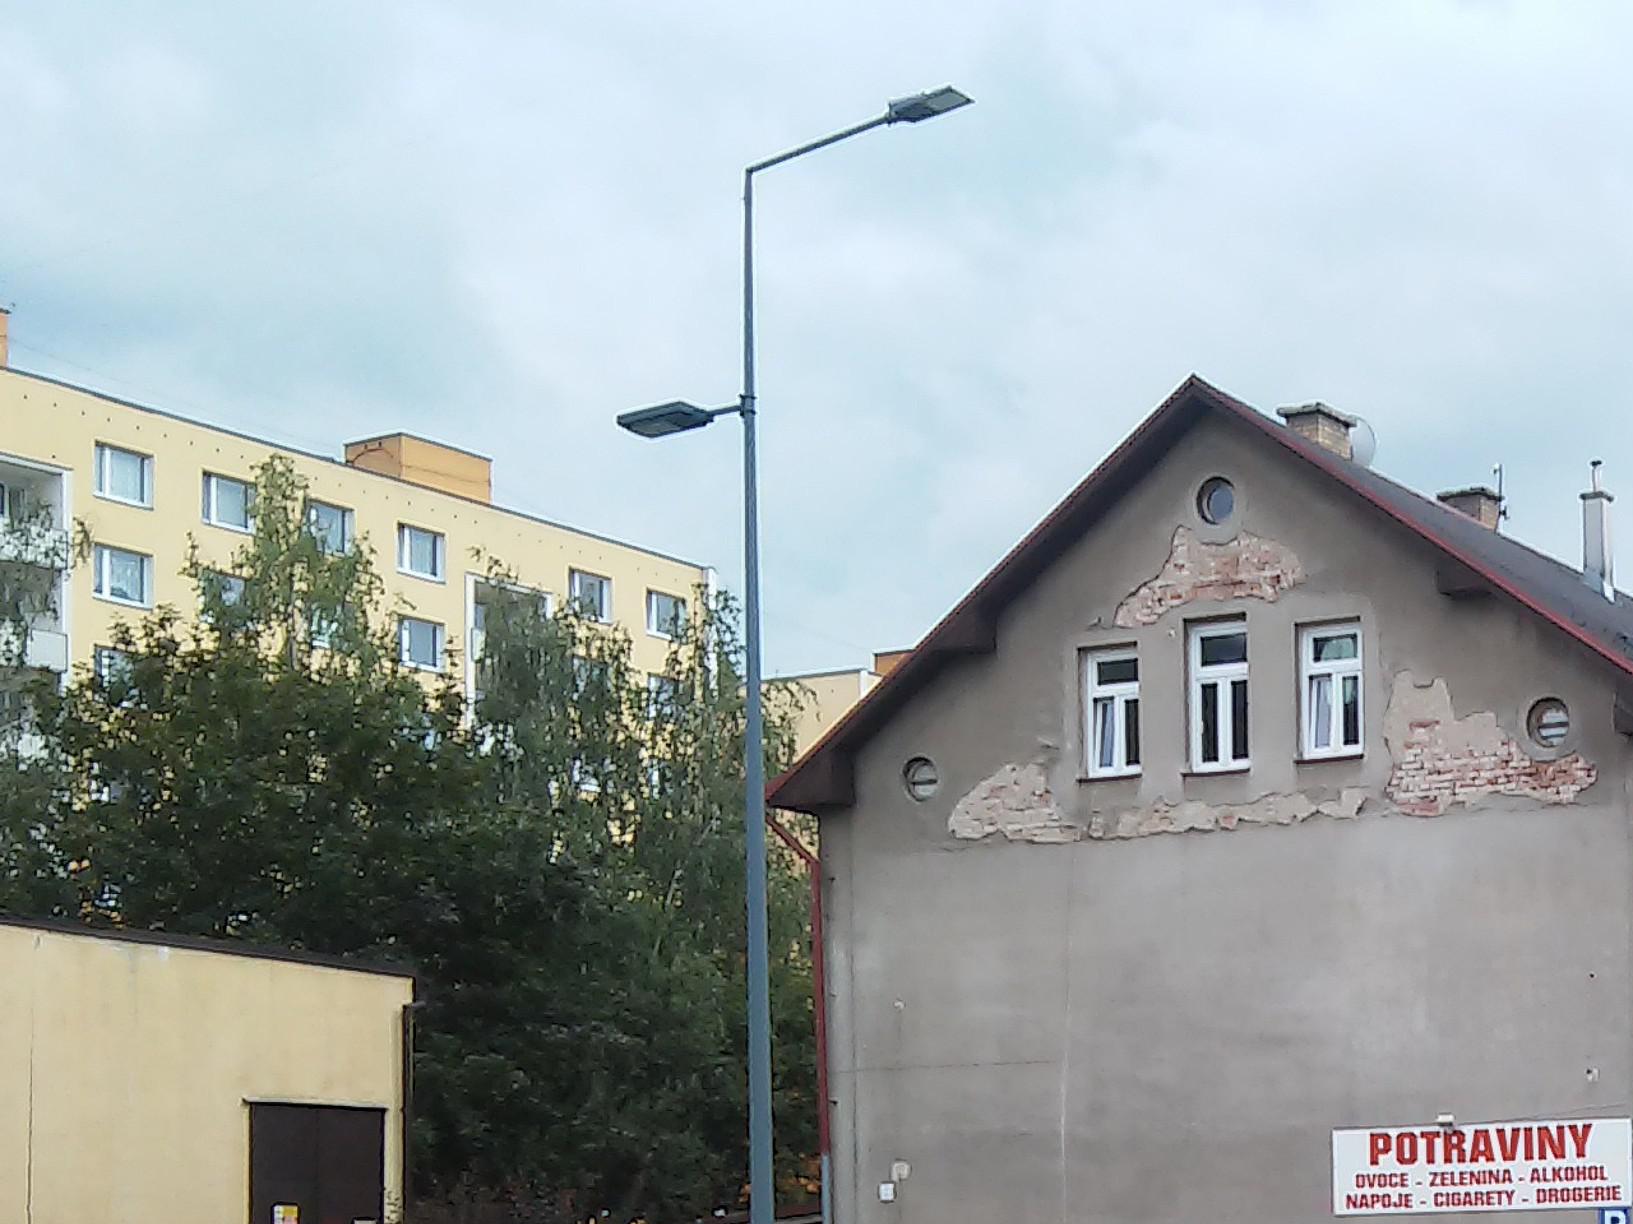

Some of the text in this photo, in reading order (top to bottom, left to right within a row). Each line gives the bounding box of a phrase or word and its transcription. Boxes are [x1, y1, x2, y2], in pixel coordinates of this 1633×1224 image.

[1369, 1123, 1593, 1166] POTRAVINY
[1355, 1172, 1409, 1189] OVOCE
[1429, 1168, 1513, 1188] ZELENINA
[1530, 1165, 1609, 1184] ALKOHOL
[1433, 1189, 1516, 1208] CIGARETY
[1536, 1185, 1623, 1205] DROGERIE
